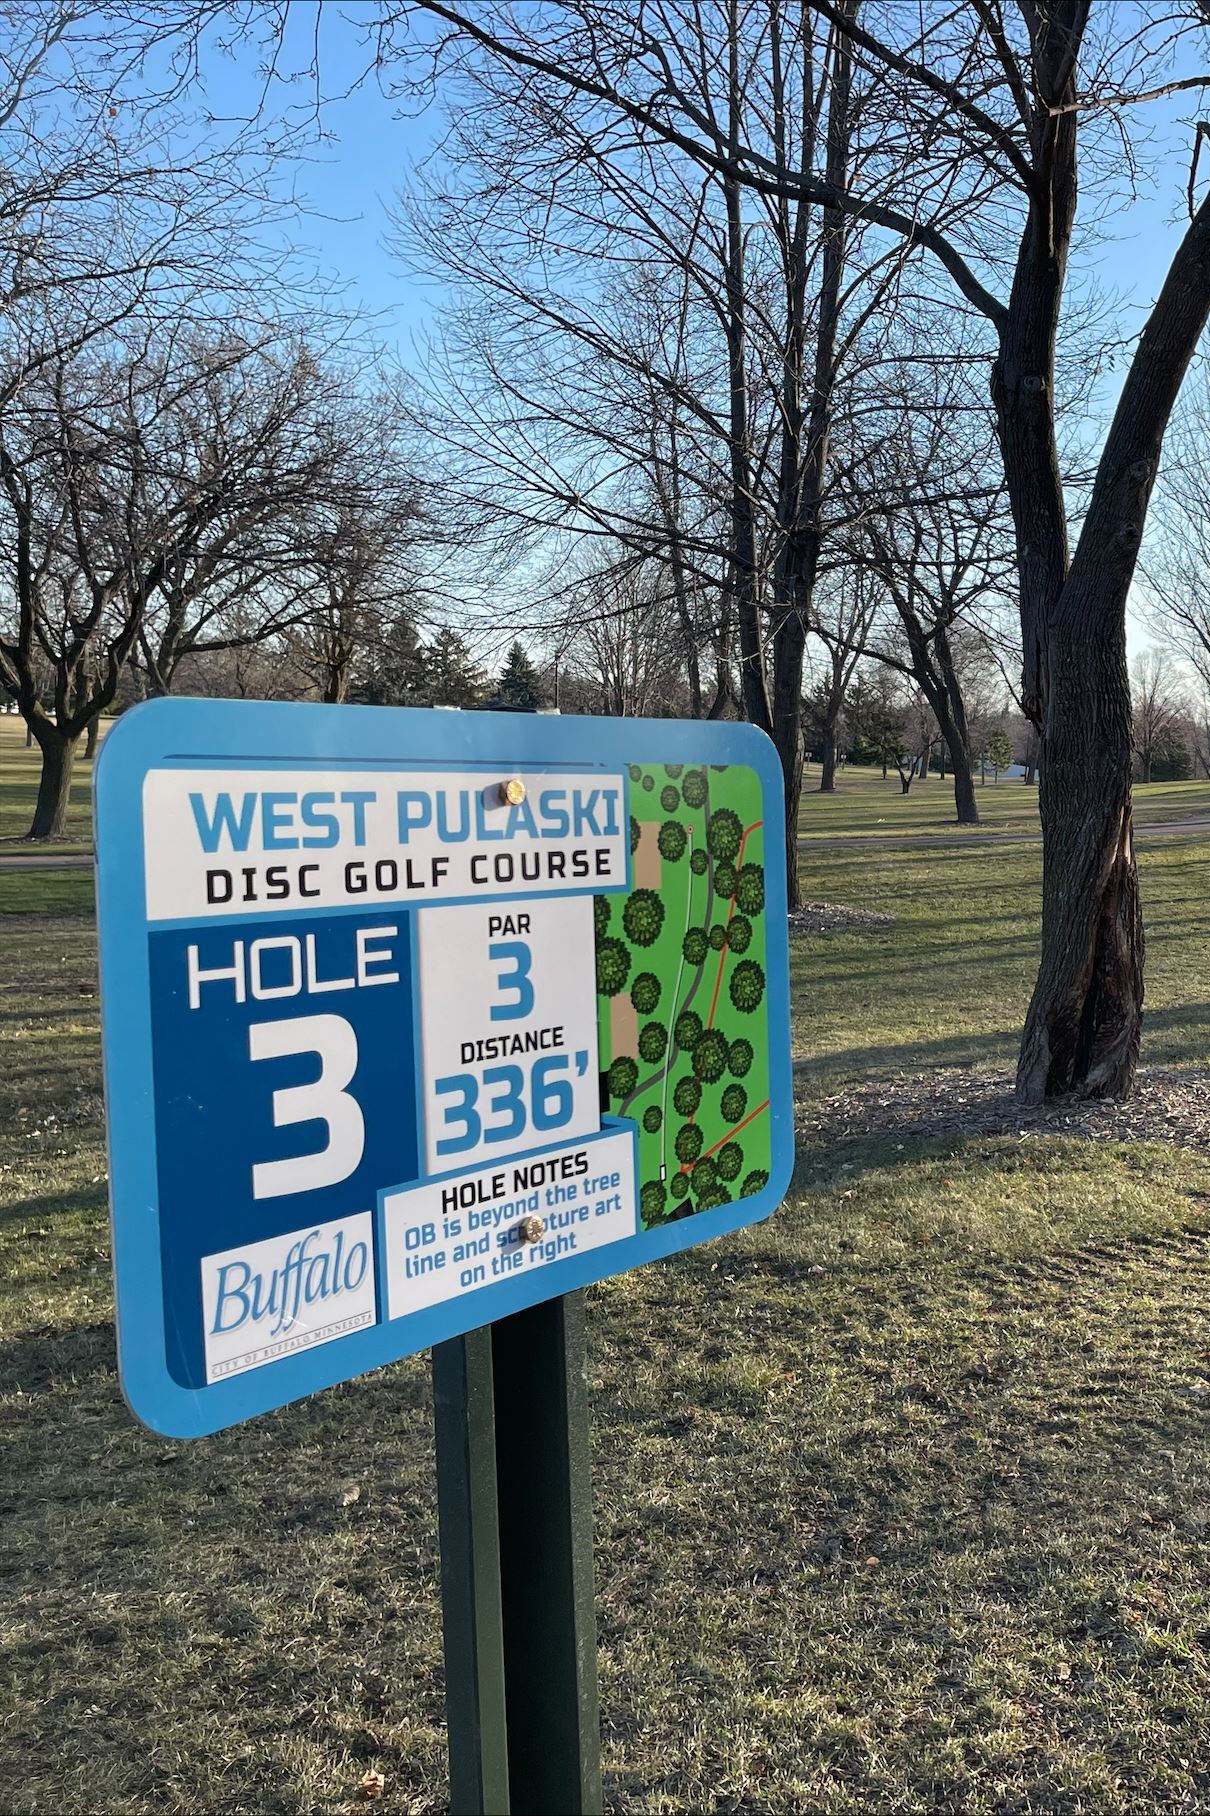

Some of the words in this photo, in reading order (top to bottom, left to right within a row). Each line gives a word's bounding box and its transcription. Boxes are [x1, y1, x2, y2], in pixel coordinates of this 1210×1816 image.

[189, 791, 378, 853] WEST
[399, 788, 620, 845] PULASKI
[206, 864, 320, 904] DISC
[345, 857, 450, 894] GOLF
[471, 848, 612, 884] COURSE
[488, 913, 531, 937] PAR
[187, 926, 400, 1009] HOLE
[488, 941, 535, 1021] 3
[460, 1026, 564, 1065] DISTANCE
[249, 1013, 365, 1200] 3
[434, 1049, 589, 1156] 336'
[404, 1222, 436, 1251] OB
[443, 1217, 462, 1239] is
[468, 1192, 539, 1229] beyond
[546, 1184, 577, 1207] the
[583, 1171, 621, 1195] tree
[442, 1174, 506, 1214] HOLE
[514, 1151, 589, 1193] NOTES
[405, 1253, 446, 1279] line
[453, 1232, 490, 1262] and
[496, 1205, 589, 1248] scture
[595, 1193, 622, 1215] art
[460, 1263, 485, 1287] on
[491, 1251, 523, 1276] the
[529, 1231, 577, 1263] right
[209, 1229, 368, 1337] Buffalo
[211, 1360, 239, 1376] CITY
[244, 1353, 258, 1364] OF
[264, 1335, 311, 1358] BUFFALO
[314, 1312, 372, 1340] MINNESOTA
